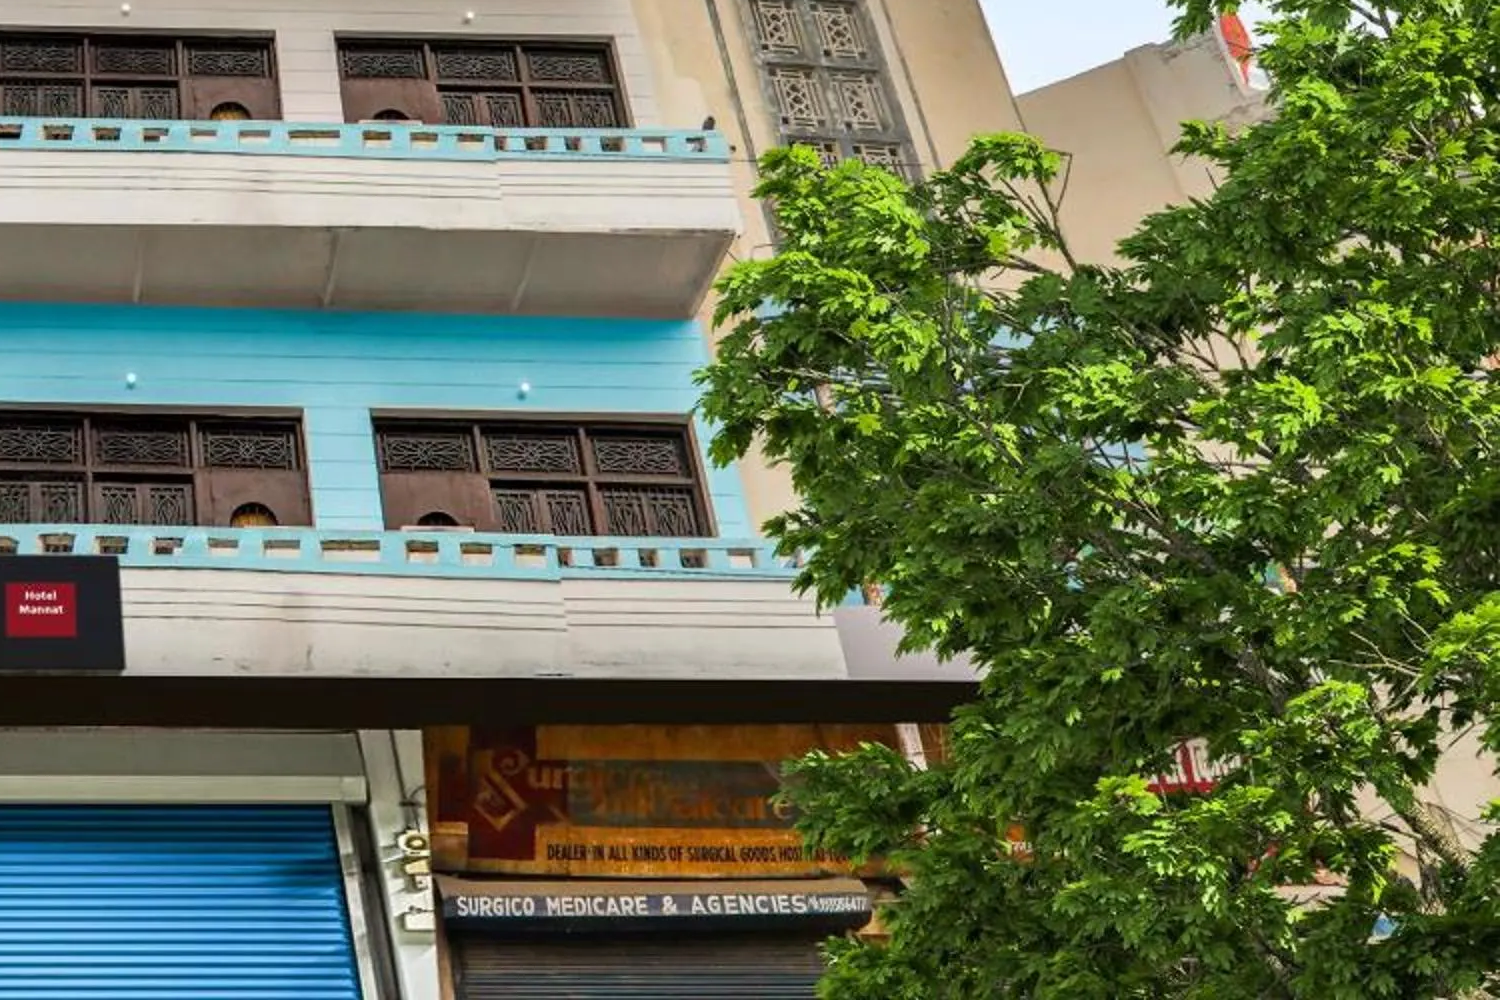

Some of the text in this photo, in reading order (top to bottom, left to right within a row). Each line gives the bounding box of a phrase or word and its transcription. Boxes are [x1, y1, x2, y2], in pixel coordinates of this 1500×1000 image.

[24, 590, 58, 601] Hotel
[18, 603, 65, 615] Mannat
[547, 843, 587, 861] DEALER
[609, 844, 628, 861] ALL
[631, 844, 667, 861] KINDS
[669, 845, 683, 862] OF
[687, 845, 738, 863] SURGICAL
[457, 896, 535, 916] SURGICO
[546, 895, 649, 916] MEDICARE
[662, 895, 678, 916] &
[691, 895, 806, 915] AGENCIES
